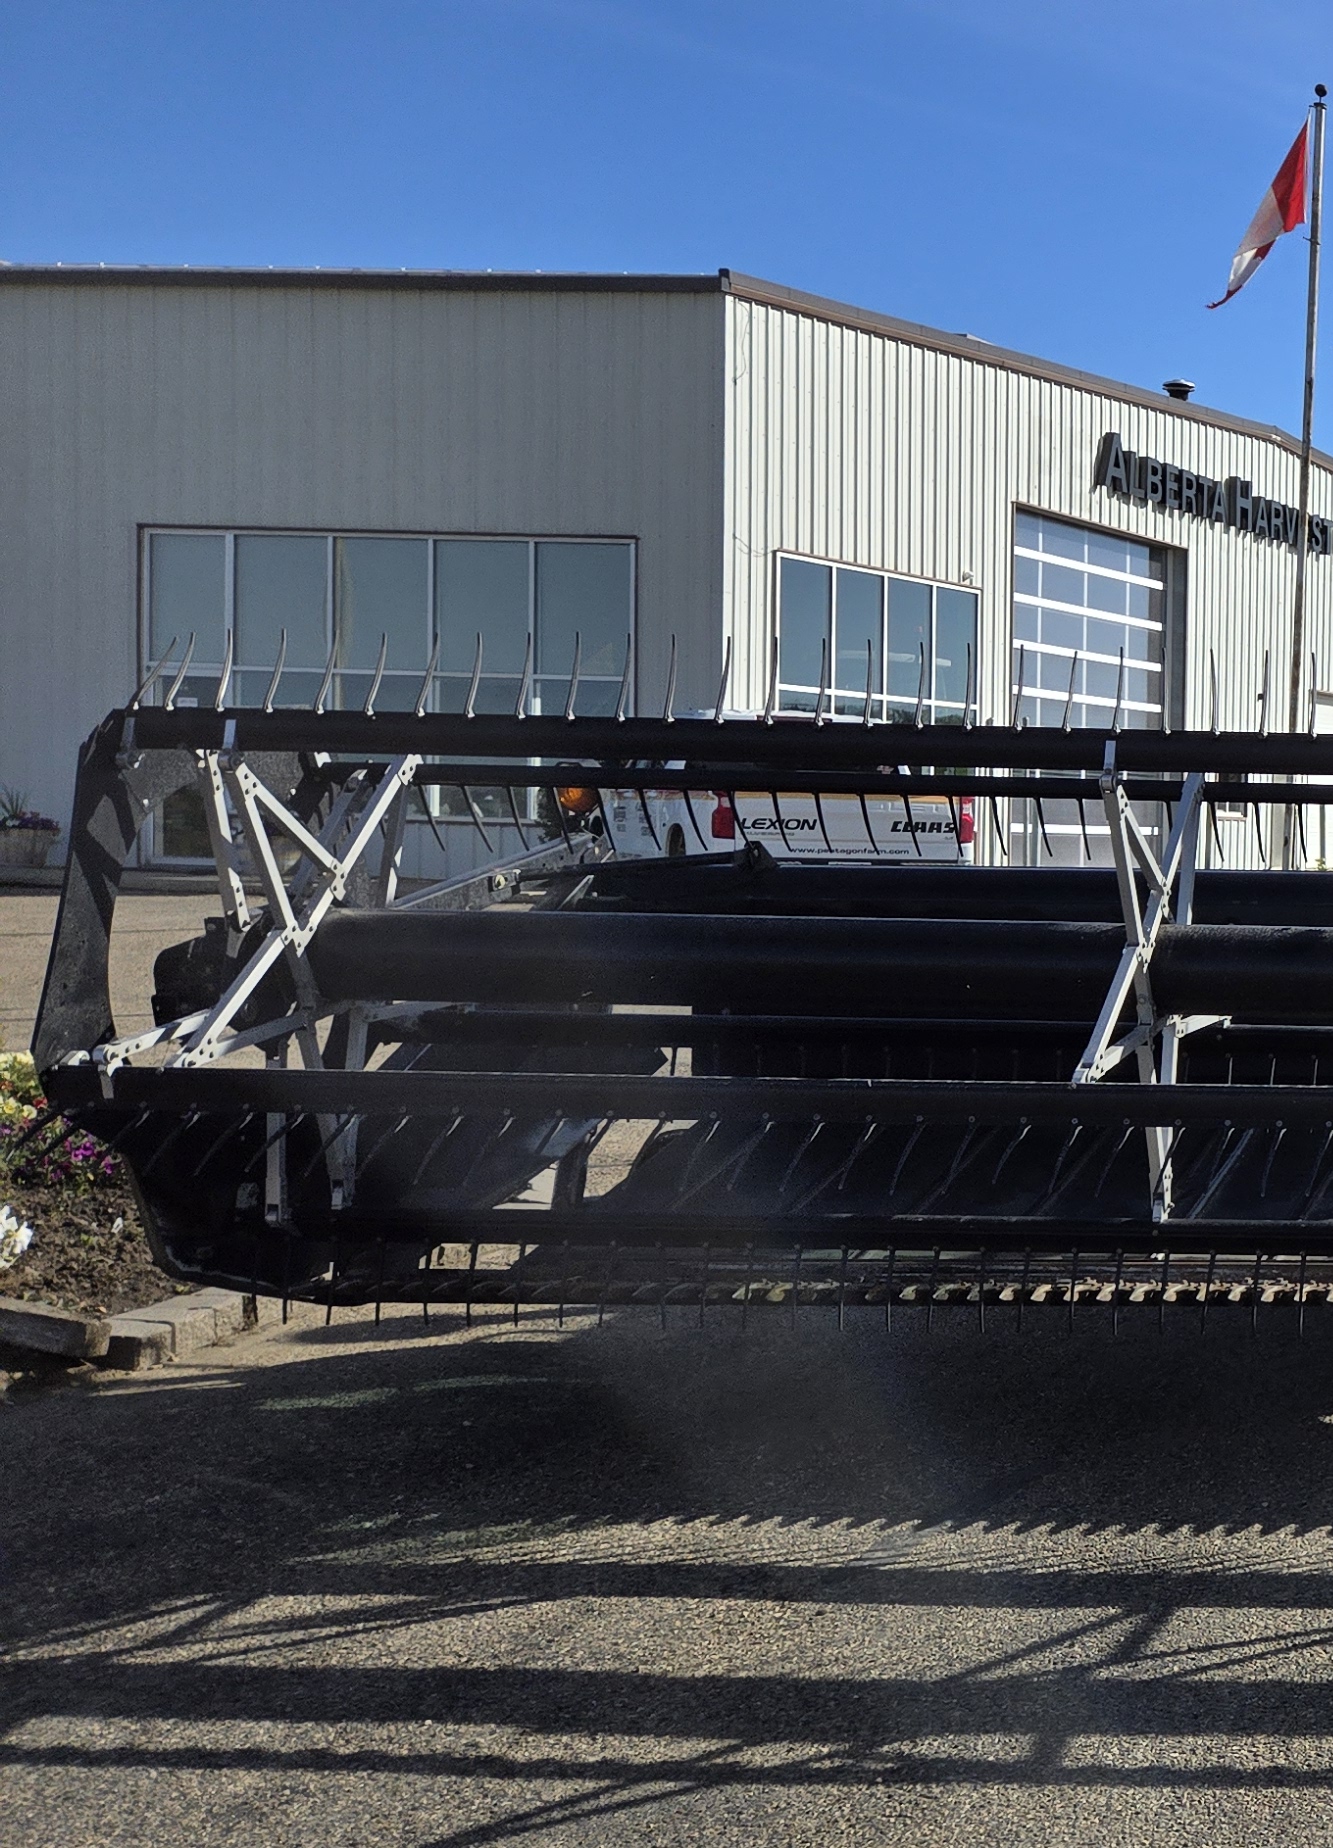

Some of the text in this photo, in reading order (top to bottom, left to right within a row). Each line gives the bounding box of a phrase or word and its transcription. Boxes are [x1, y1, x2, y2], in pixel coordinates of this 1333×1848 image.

[1098, 432, 1227, 523] ALBERTA
[741, 818, 817, 830] LEXION
[891, 821, 956, 833] CLAAS
